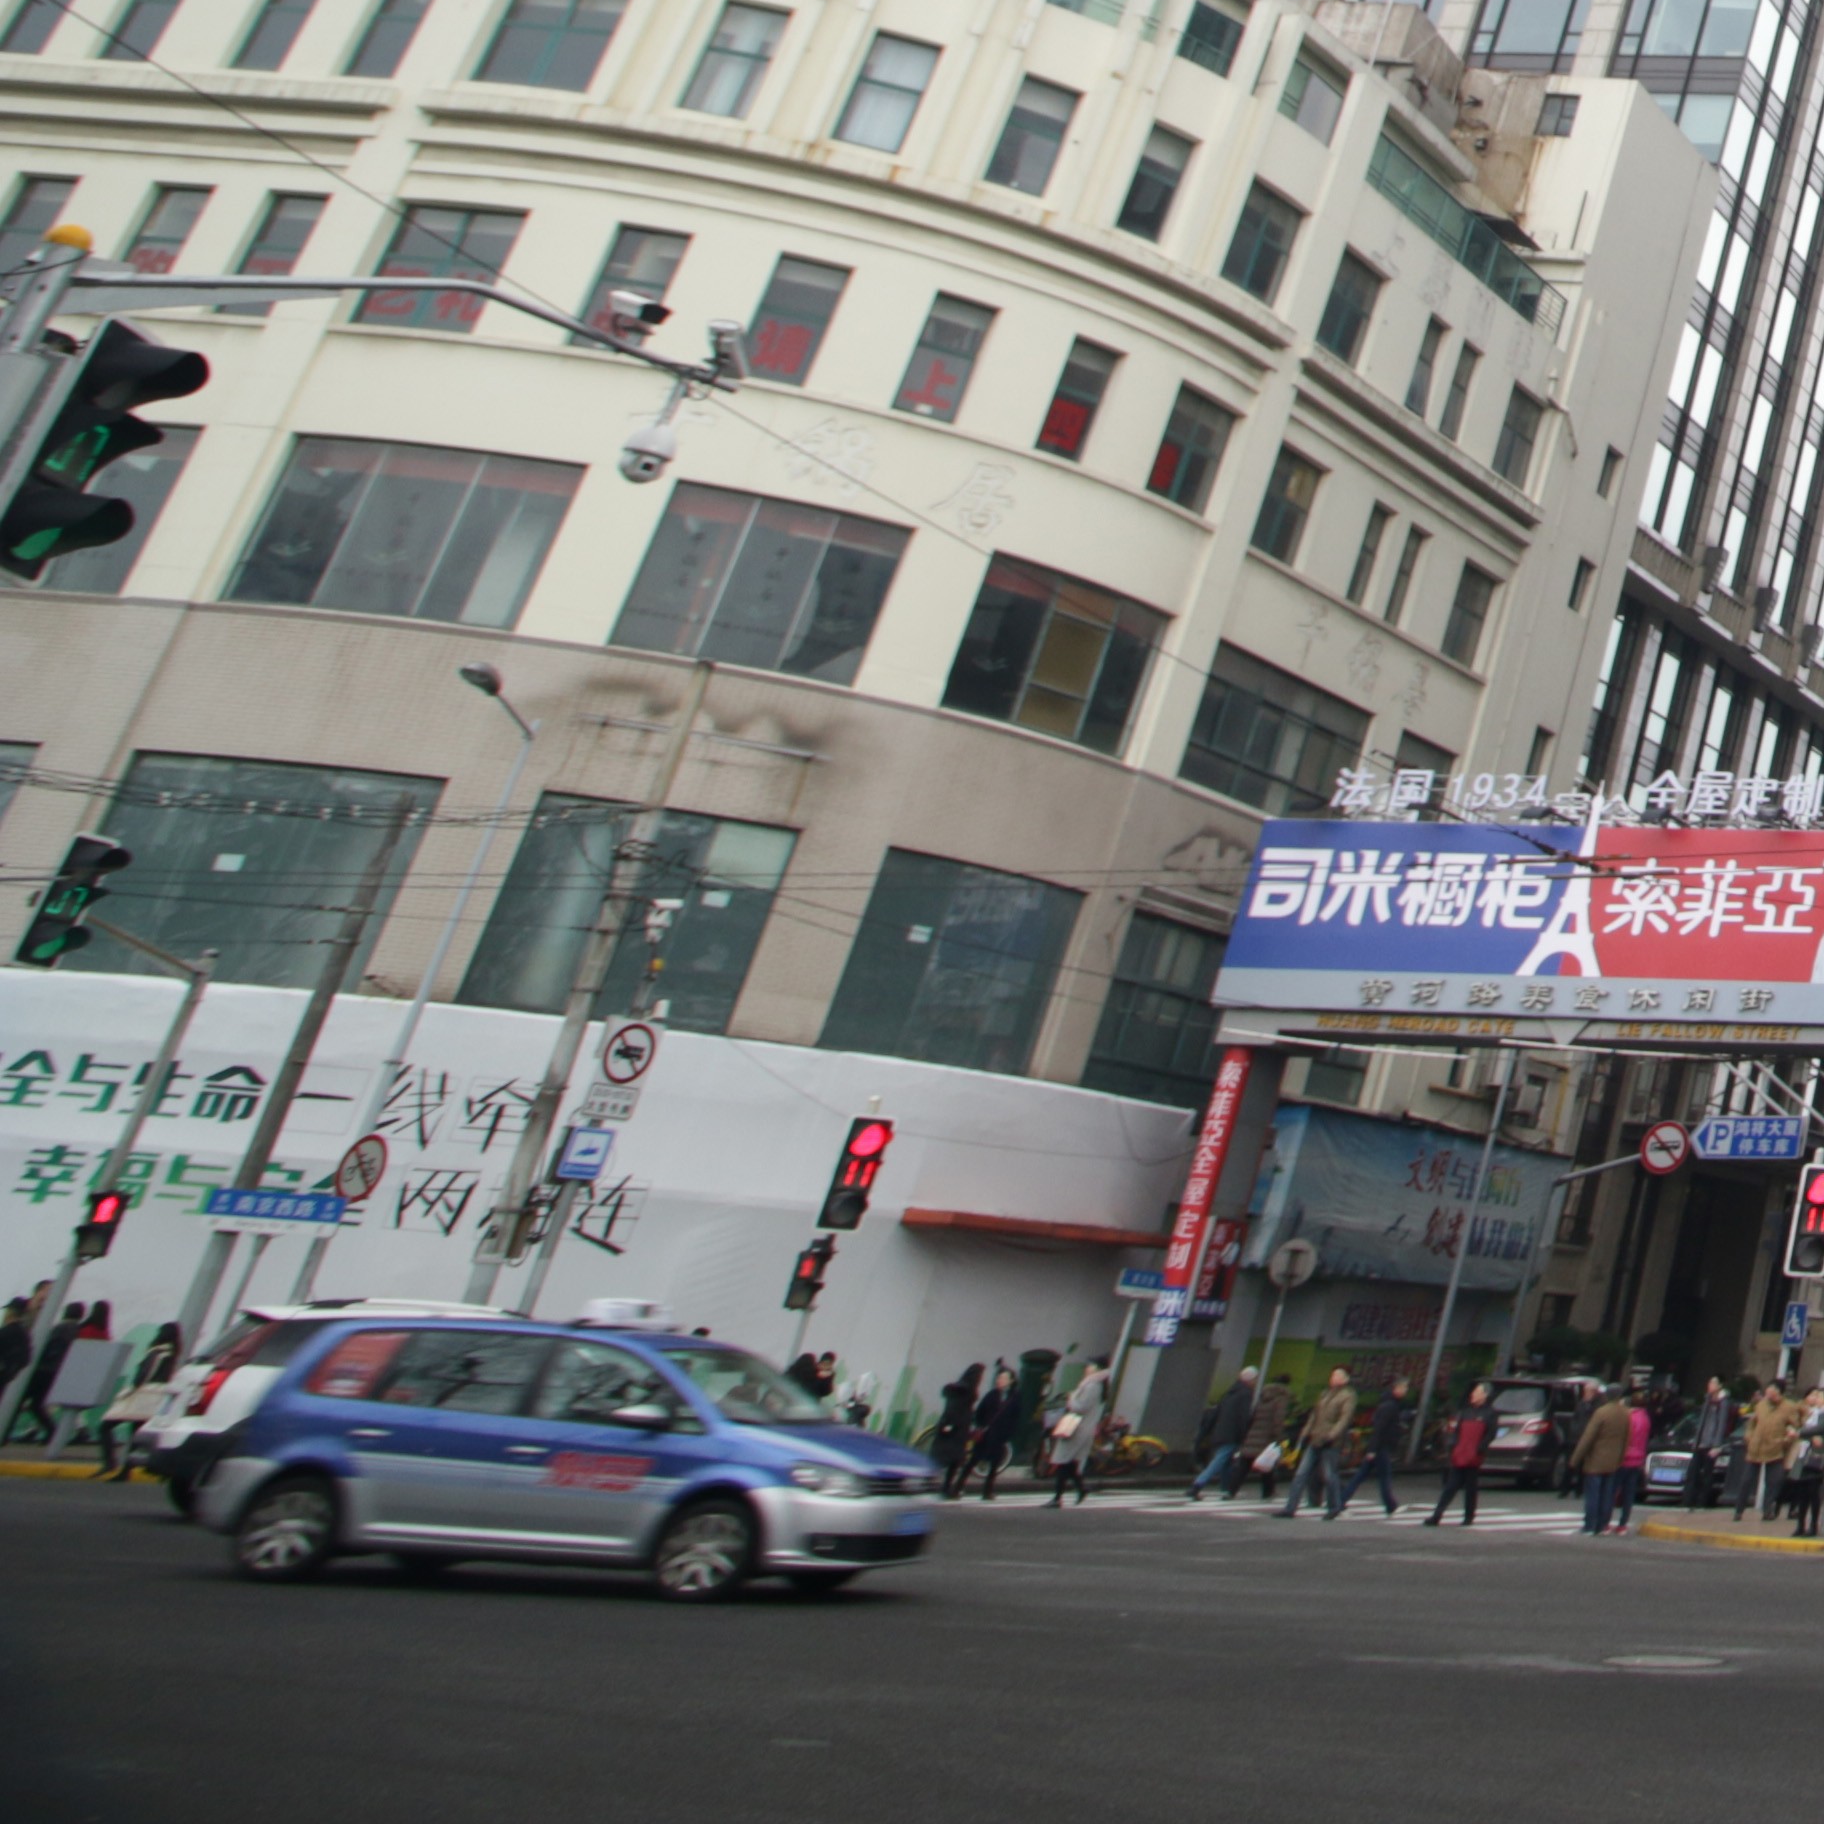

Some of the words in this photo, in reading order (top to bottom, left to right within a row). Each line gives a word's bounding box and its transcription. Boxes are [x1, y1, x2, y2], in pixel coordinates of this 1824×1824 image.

[1330, 767, 1435, 808] 法国
[1451, 773, 1547, 809] 1934
[1646, 769, 1824, 819] 全屋定制
[1247, 847, 1561, 929] 司米橱柜
[1604, 857, 1816, 937] 索菲亞
[1360, 978, 1775, 1013] 黄河路美食休闲街
[1650, 1024, 1723, 1040] FALLOW
[1733, 1025, 1803, 1042] STREET
[0, 1049, 550, 1153] 全与生命一线牵
[1711, 1123, 1729, 1151] P
[1734, 1119, 1800, 1137] 鸿祥大厦
[1738, 1138, 1790, 1155] 停车库
[843, 1159, 878, 1187] 11
